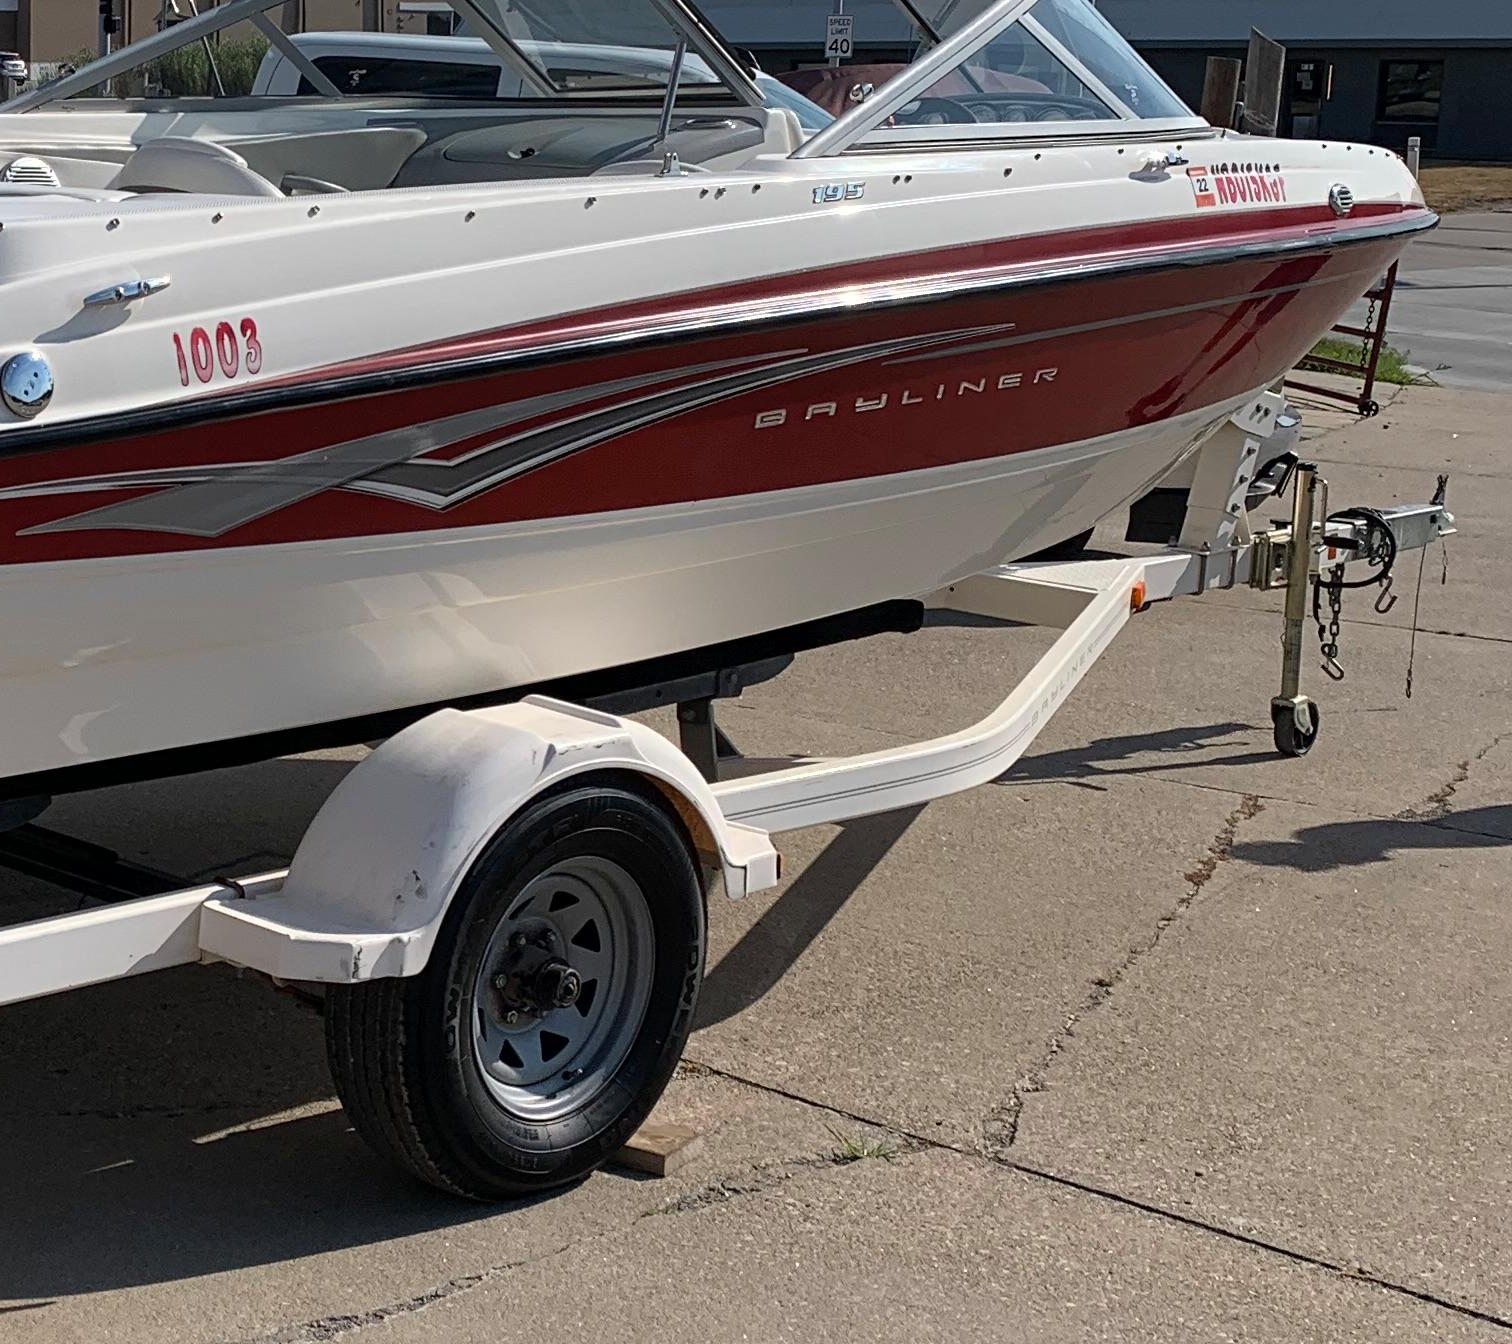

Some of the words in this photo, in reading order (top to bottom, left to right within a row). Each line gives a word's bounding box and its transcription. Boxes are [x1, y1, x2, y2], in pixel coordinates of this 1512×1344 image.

[829, 18, 851, 26] SPEED
[830, 27, 849, 36] LIMIT
[828, 38, 850, 54] 40
[812, 181, 866, 204] 195
[1196, 178, 1209, 192] 22
[173, 317, 262, 387] 1003
[754, 367, 1058, 429] BAYLINER
